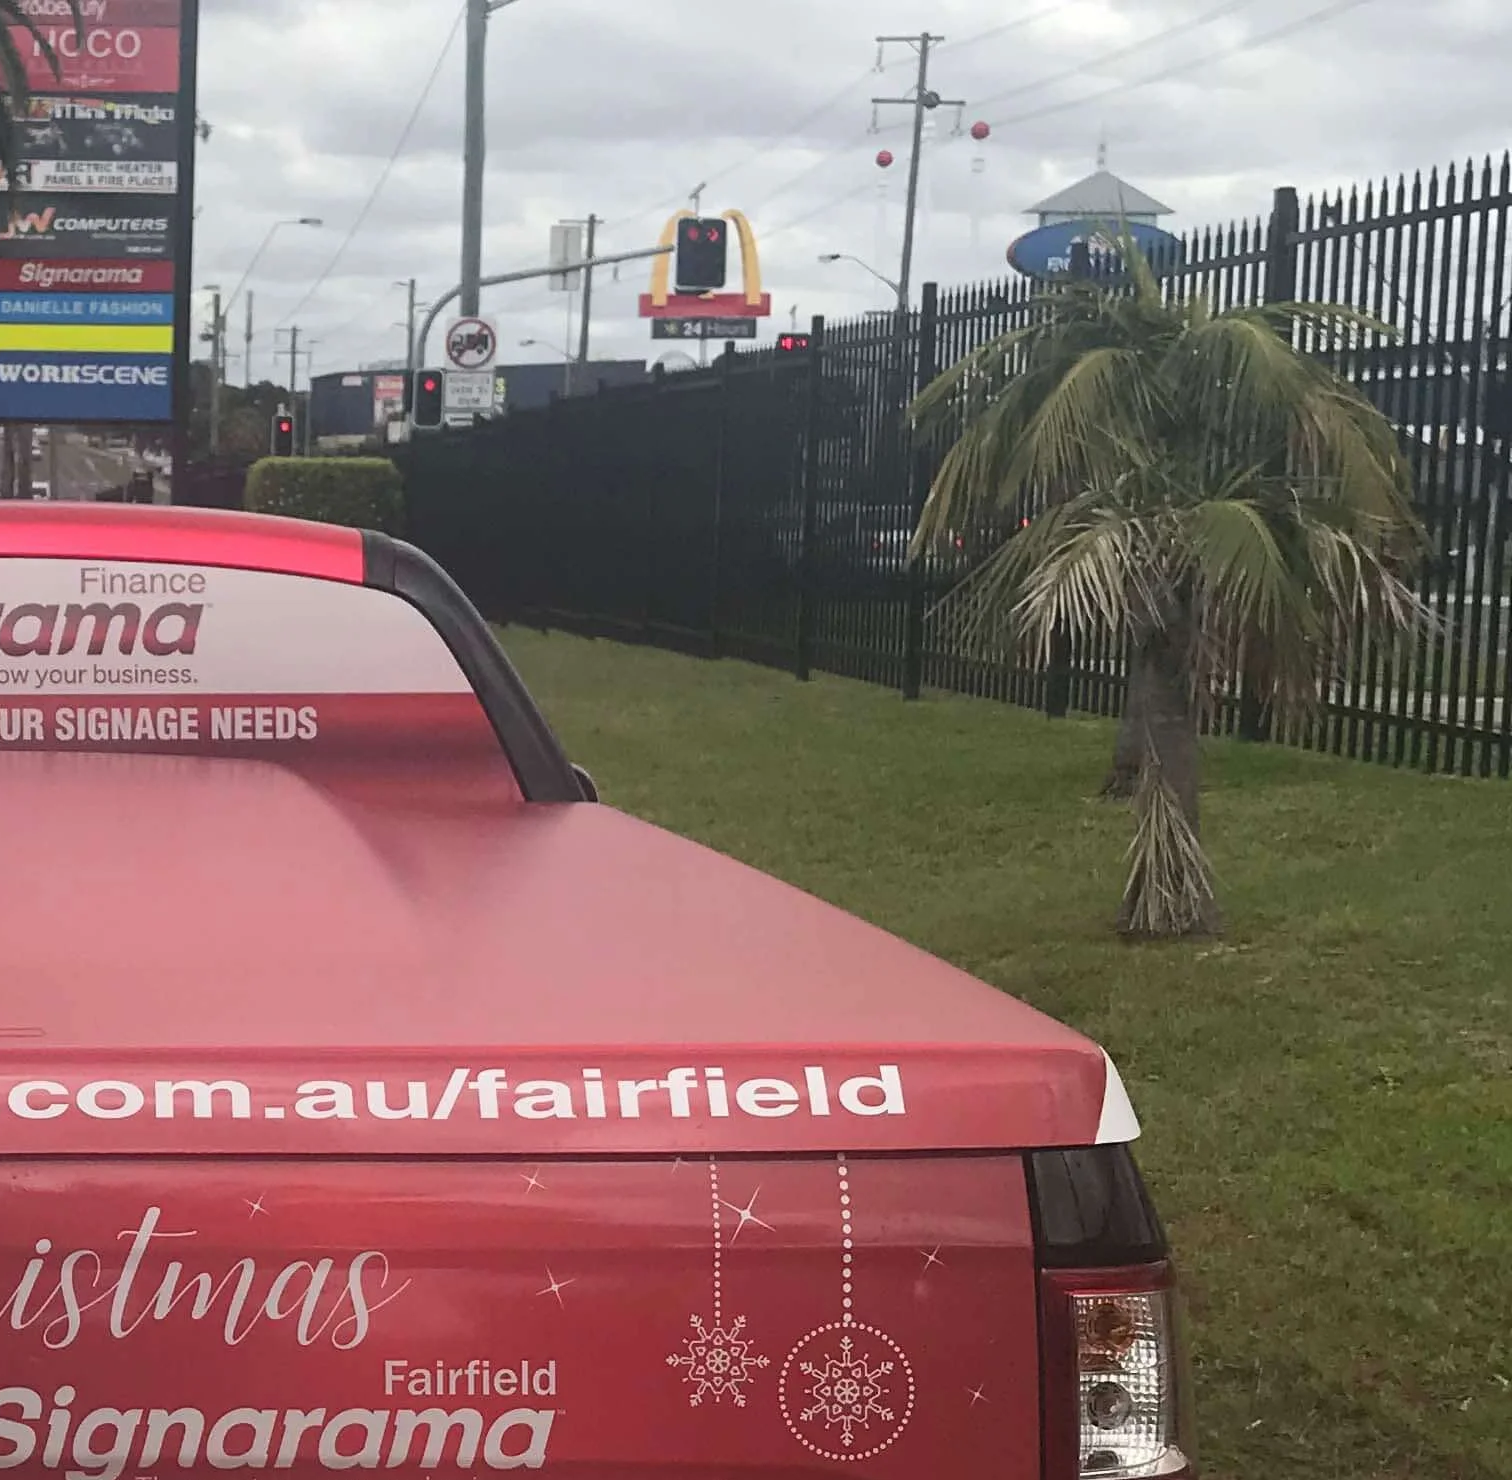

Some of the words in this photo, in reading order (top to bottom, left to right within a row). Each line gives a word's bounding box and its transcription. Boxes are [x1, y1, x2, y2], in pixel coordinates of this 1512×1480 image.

[116, 162, 163, 174] HEATER
[53, 217, 168, 231] COMPUTERS
[19, 263, 143, 287] Signarama
[1, 300, 83, 315] DANIELLE
[89, 301, 163, 316] FASHION
[683, 321, 702, 337] 24
[81, 567, 206, 594] Finance
[35, 669, 88, 690] your
[94, 663, 199, 685] business.
[56, 707, 199, 741] SIGNAGE
[212, 706, 318, 740] NEEDS
[384, 1359, 557, 1396] Fairfield
